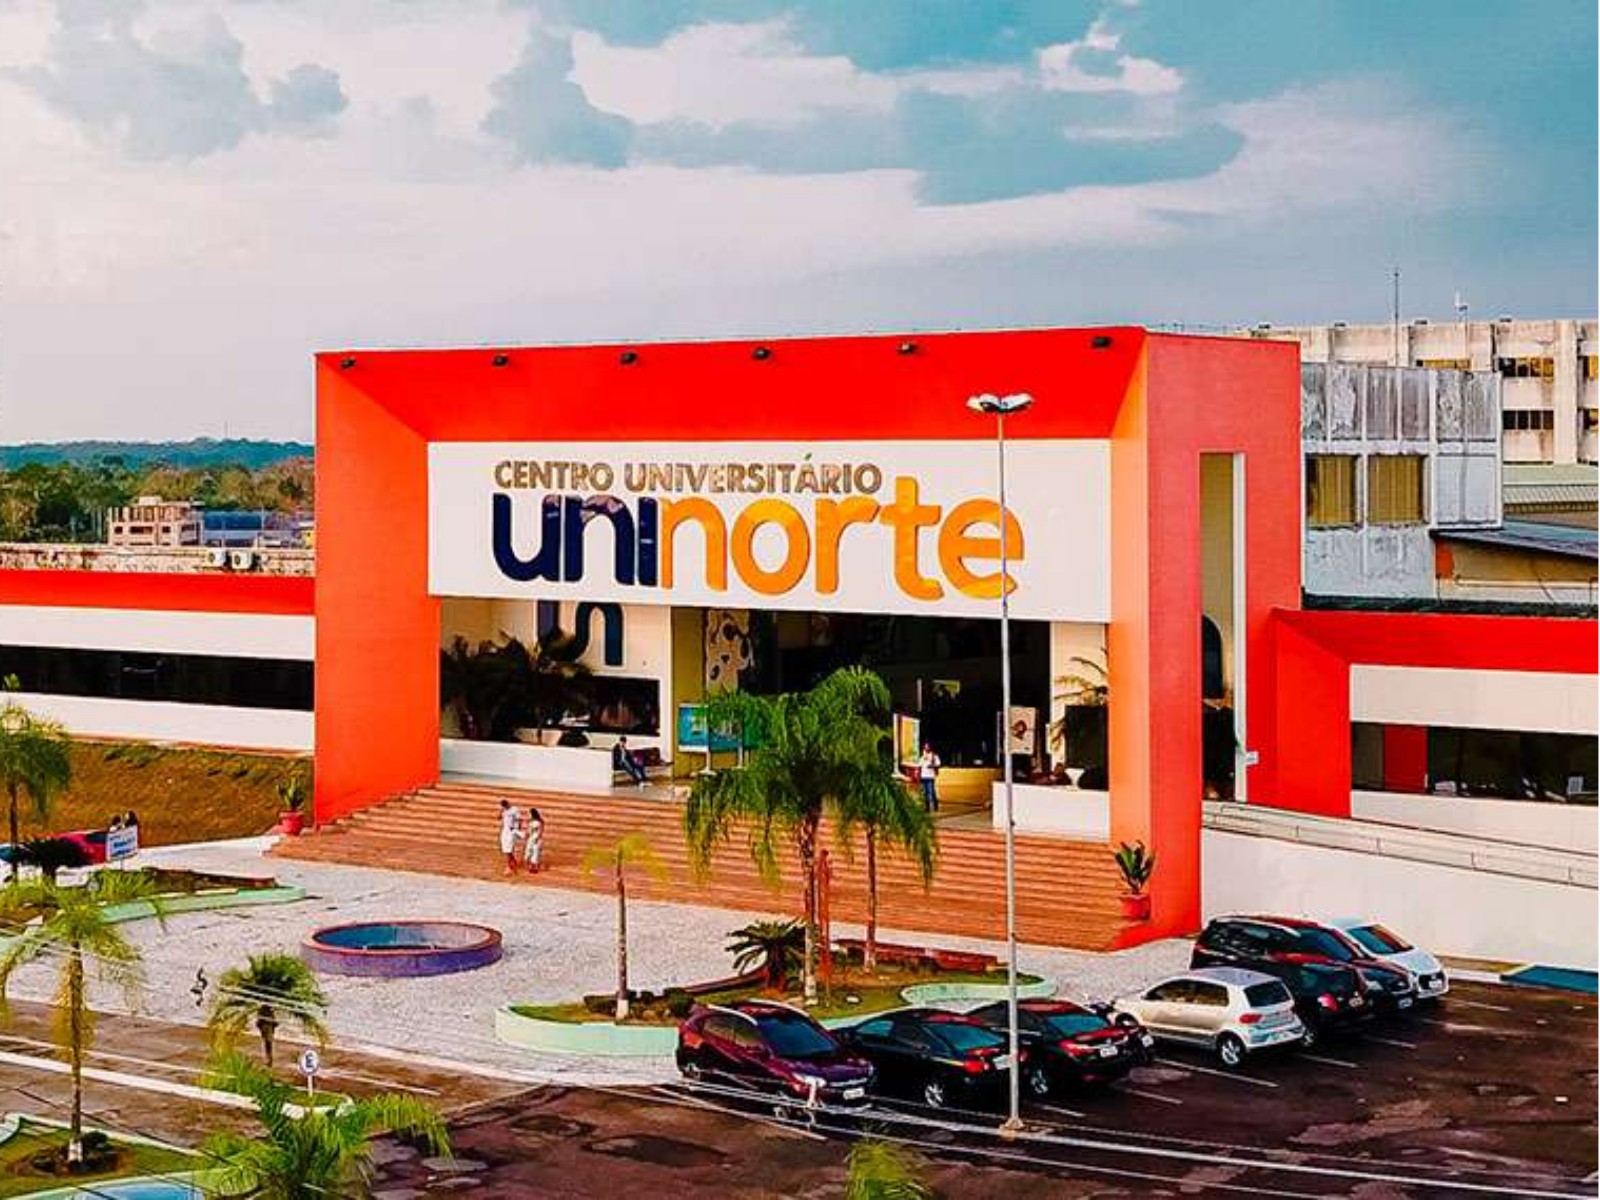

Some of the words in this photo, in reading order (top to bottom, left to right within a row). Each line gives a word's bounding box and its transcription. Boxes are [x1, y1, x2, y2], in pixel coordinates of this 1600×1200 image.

[494, 460, 615, 492] CENTRO
[624, 453, 882, 494] UNIVERSITÁRIO
[492, 476, 1025, 601] uninorte
